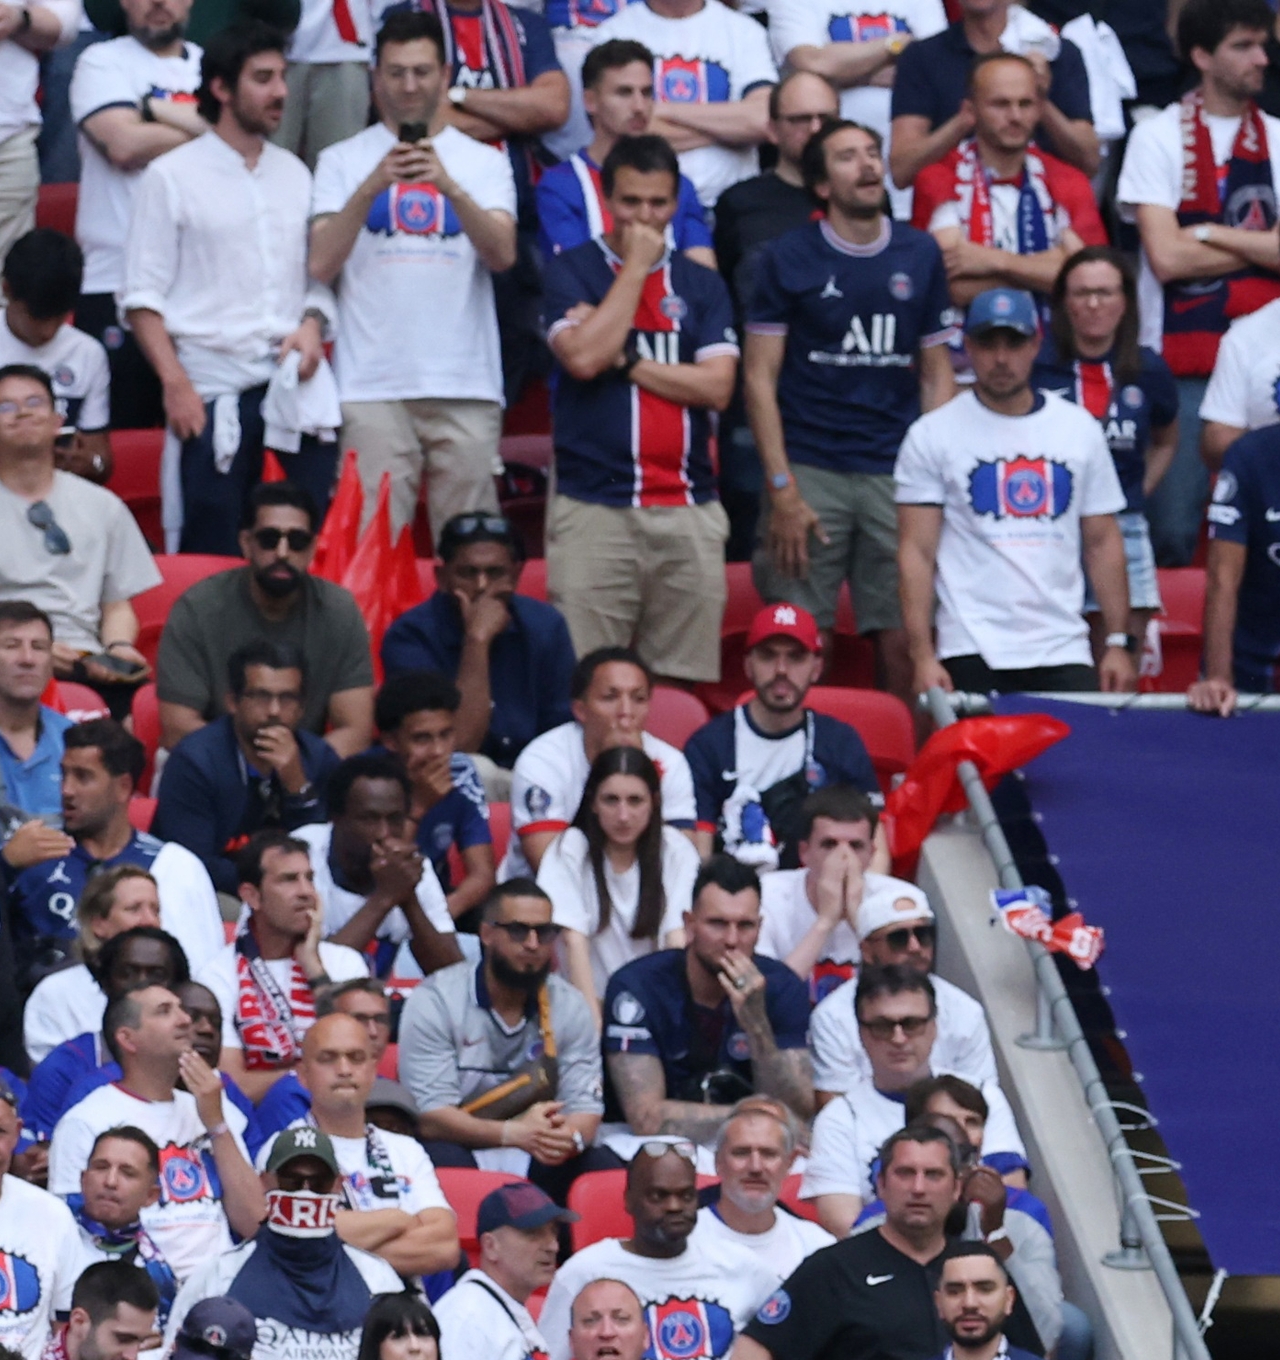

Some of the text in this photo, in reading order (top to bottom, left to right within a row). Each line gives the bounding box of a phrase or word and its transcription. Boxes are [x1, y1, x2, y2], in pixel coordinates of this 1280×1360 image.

[842, 313, 896, 355] All
[294, 1129, 318, 1148] NY
[268, 1193, 342, 1229] ARIS
